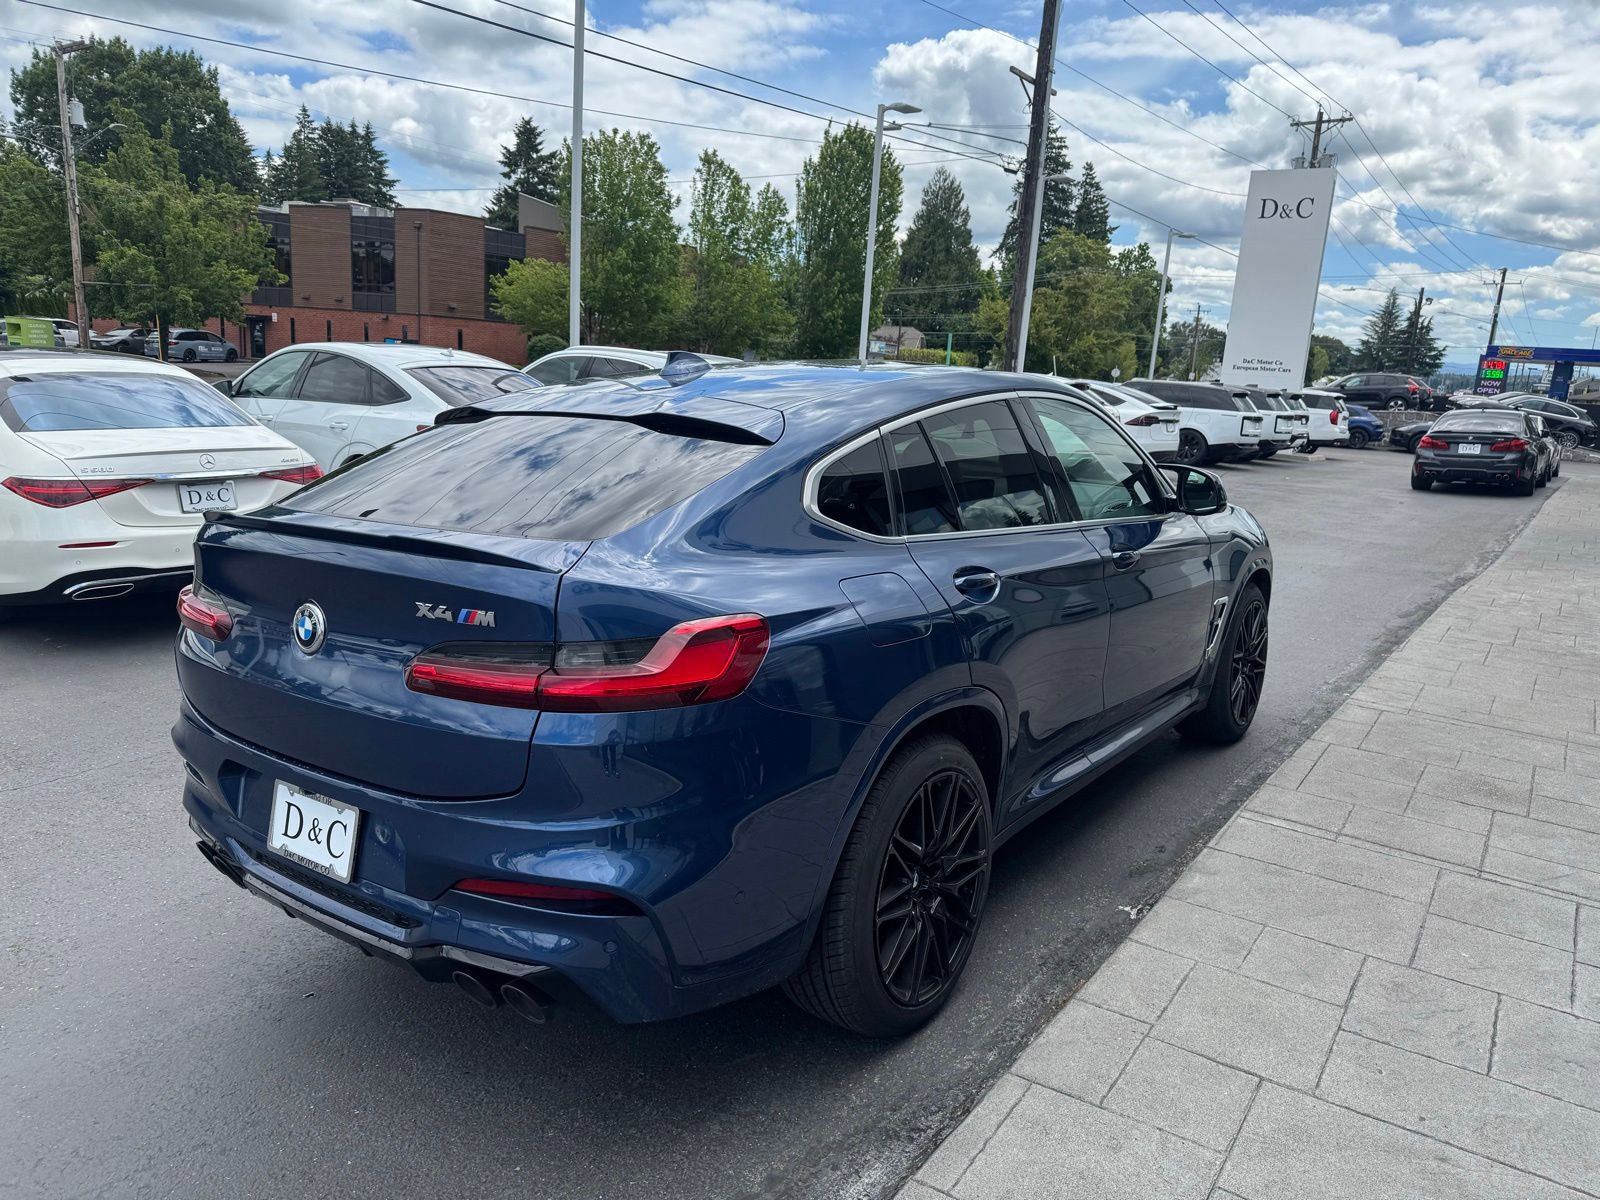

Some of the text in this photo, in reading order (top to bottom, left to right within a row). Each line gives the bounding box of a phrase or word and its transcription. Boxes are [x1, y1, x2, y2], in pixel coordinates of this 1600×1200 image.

[1258, 197, 1315, 219] D&C
[415, 601, 454, 622] X4
[297, 854, 320, 871] MOTOR
